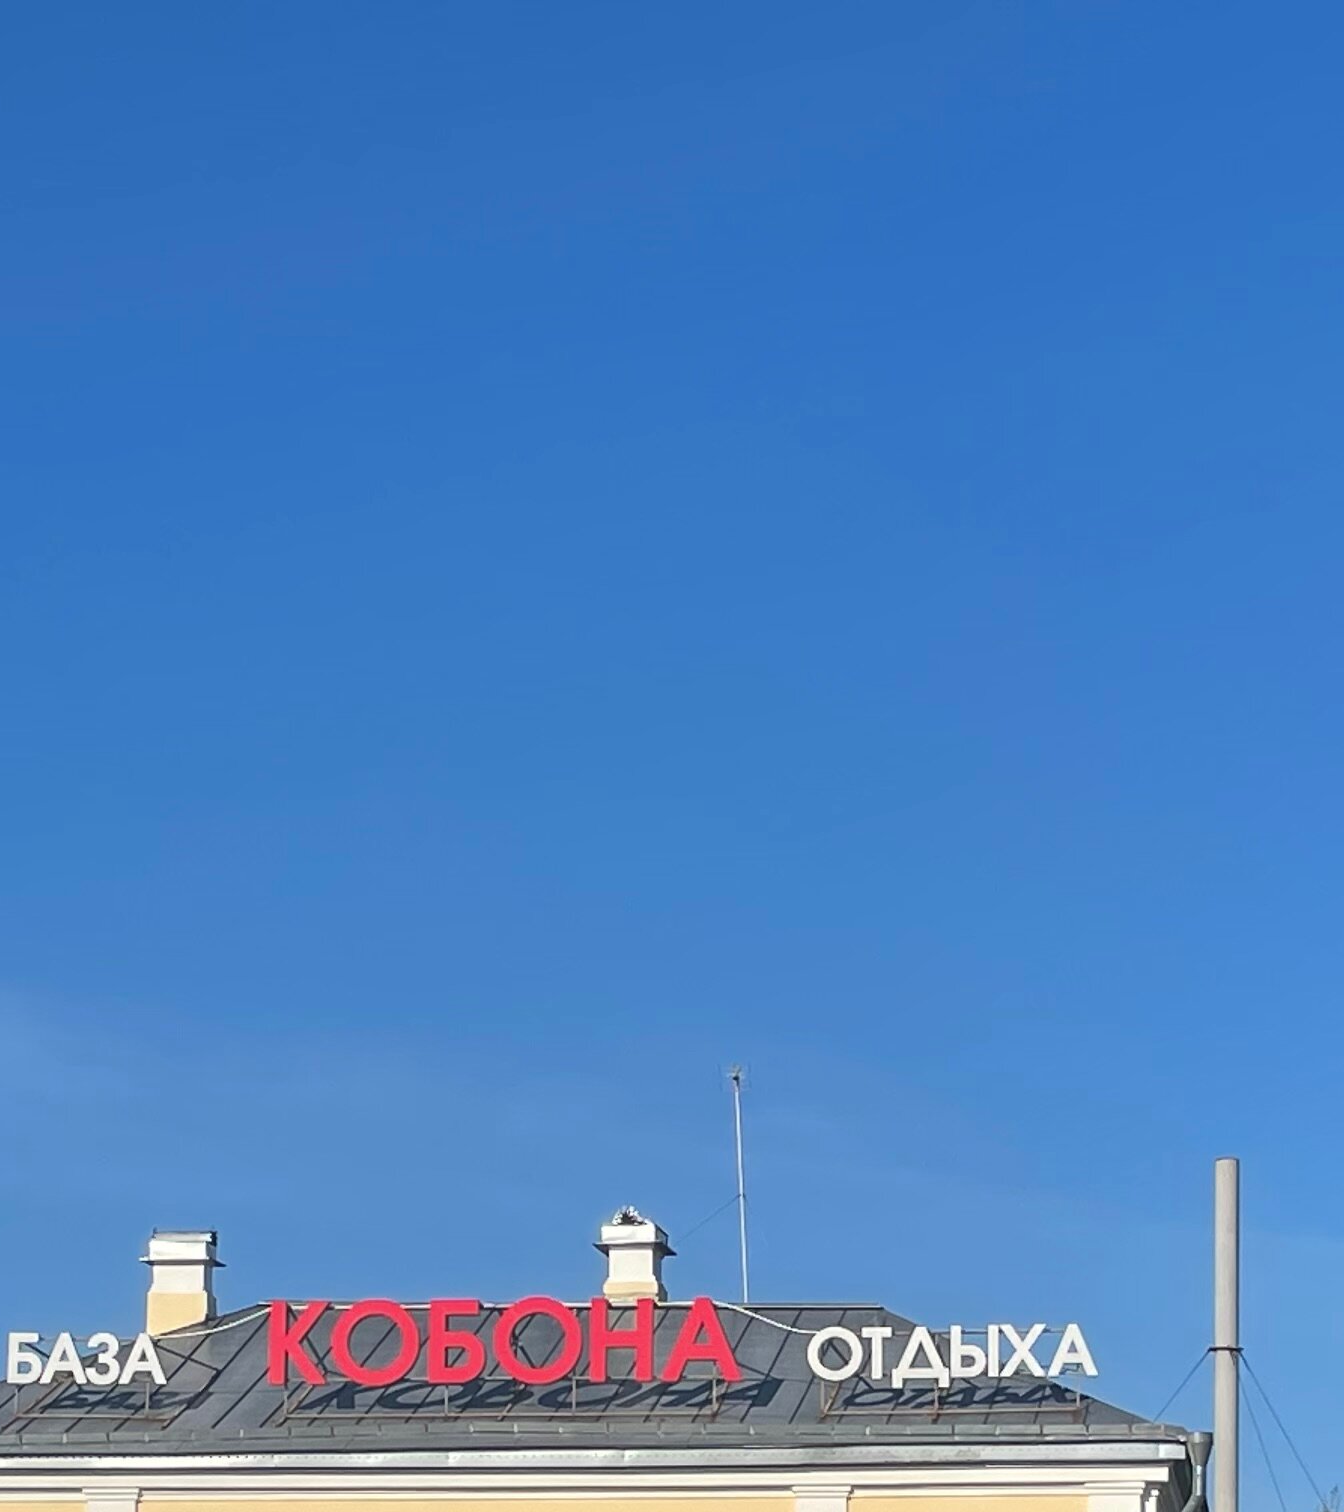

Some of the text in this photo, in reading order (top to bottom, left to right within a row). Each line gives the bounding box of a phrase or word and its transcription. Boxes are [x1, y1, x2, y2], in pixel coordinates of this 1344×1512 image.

[7, 1296, 1099, 1388] БАЗА КОБОНА ОТДЫХА
